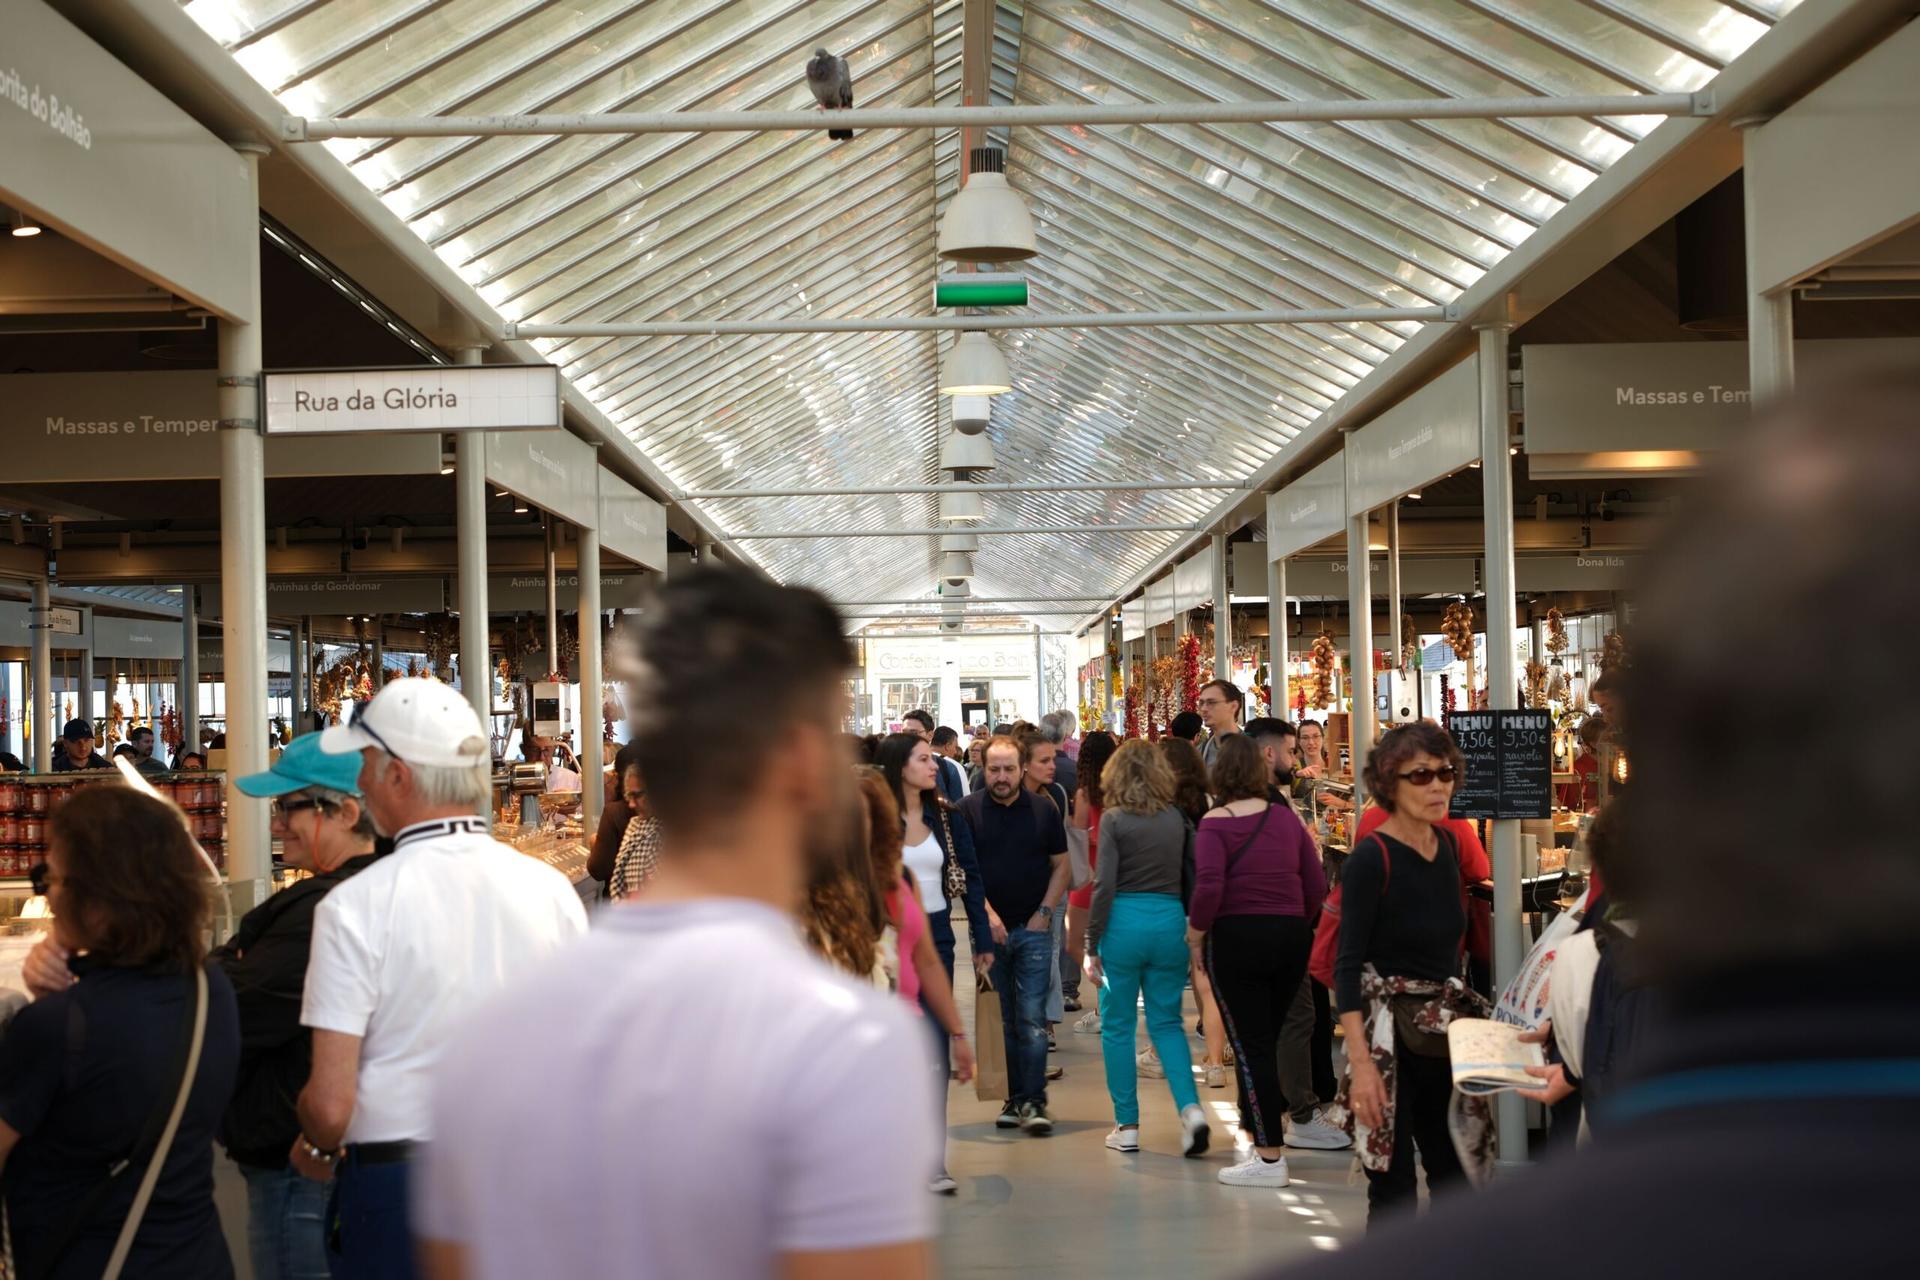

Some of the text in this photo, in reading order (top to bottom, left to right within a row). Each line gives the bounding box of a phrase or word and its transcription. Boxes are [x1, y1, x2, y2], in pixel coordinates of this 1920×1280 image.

[0, 67, 91, 150] orita do Bolhão
[295, 387, 457, 412] Rua da Glória
[1616, 385, 1751, 405] Massas e Tem
[46, 415, 218, 436] Massas e Temper
[1577, 557, 1603, 567] Dona
[268, 581, 381, 592] Aninhas de Gondomar
[511, 577, 546, 588] Aninha
[1450, 716, 1493, 731] MENU
[1501, 715, 1548, 730] MENU
[1458, 731, 1497, 749] 7,50€
[1503, 730, 1547, 749] 9,50€
